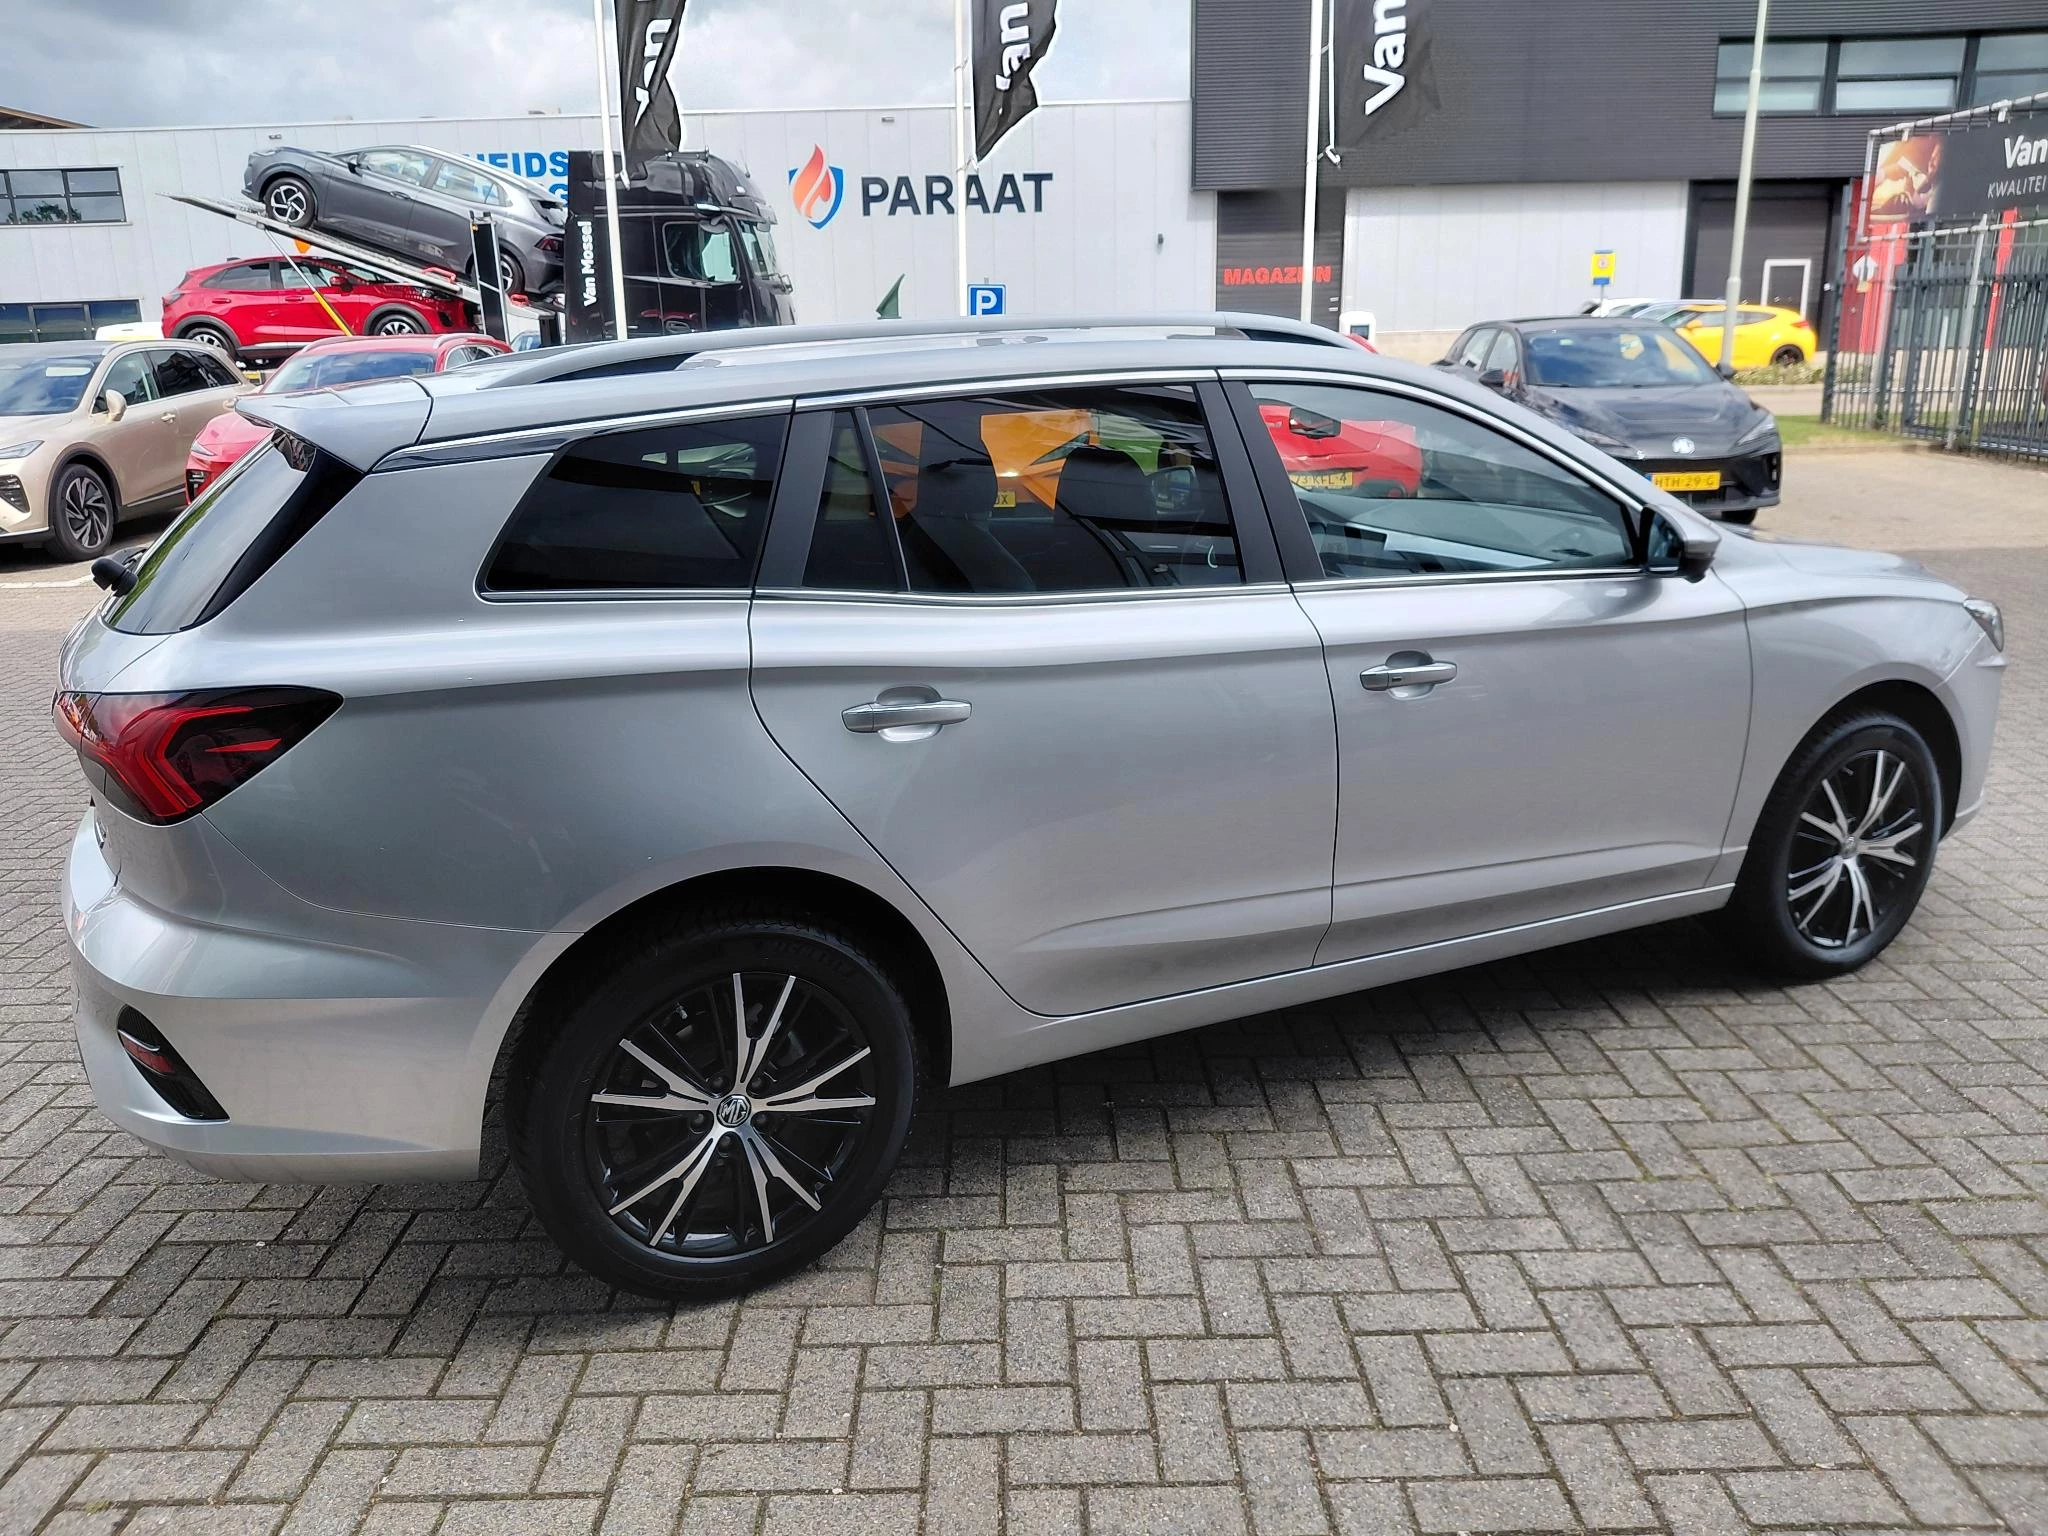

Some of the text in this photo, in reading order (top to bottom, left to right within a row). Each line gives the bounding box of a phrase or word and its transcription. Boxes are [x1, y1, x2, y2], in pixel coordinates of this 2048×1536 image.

[1363, 0, 1406, 116] Van
[2004, 135, 2048, 169] Van
[861, 173, 1053, 216] PARAAT
[1987, 175, 2047, 199] KWALITEI
[577, 221, 597, 307] Van Mossel
[976, 290, 997, 315] P
[720, 1098, 749, 1124] MG
